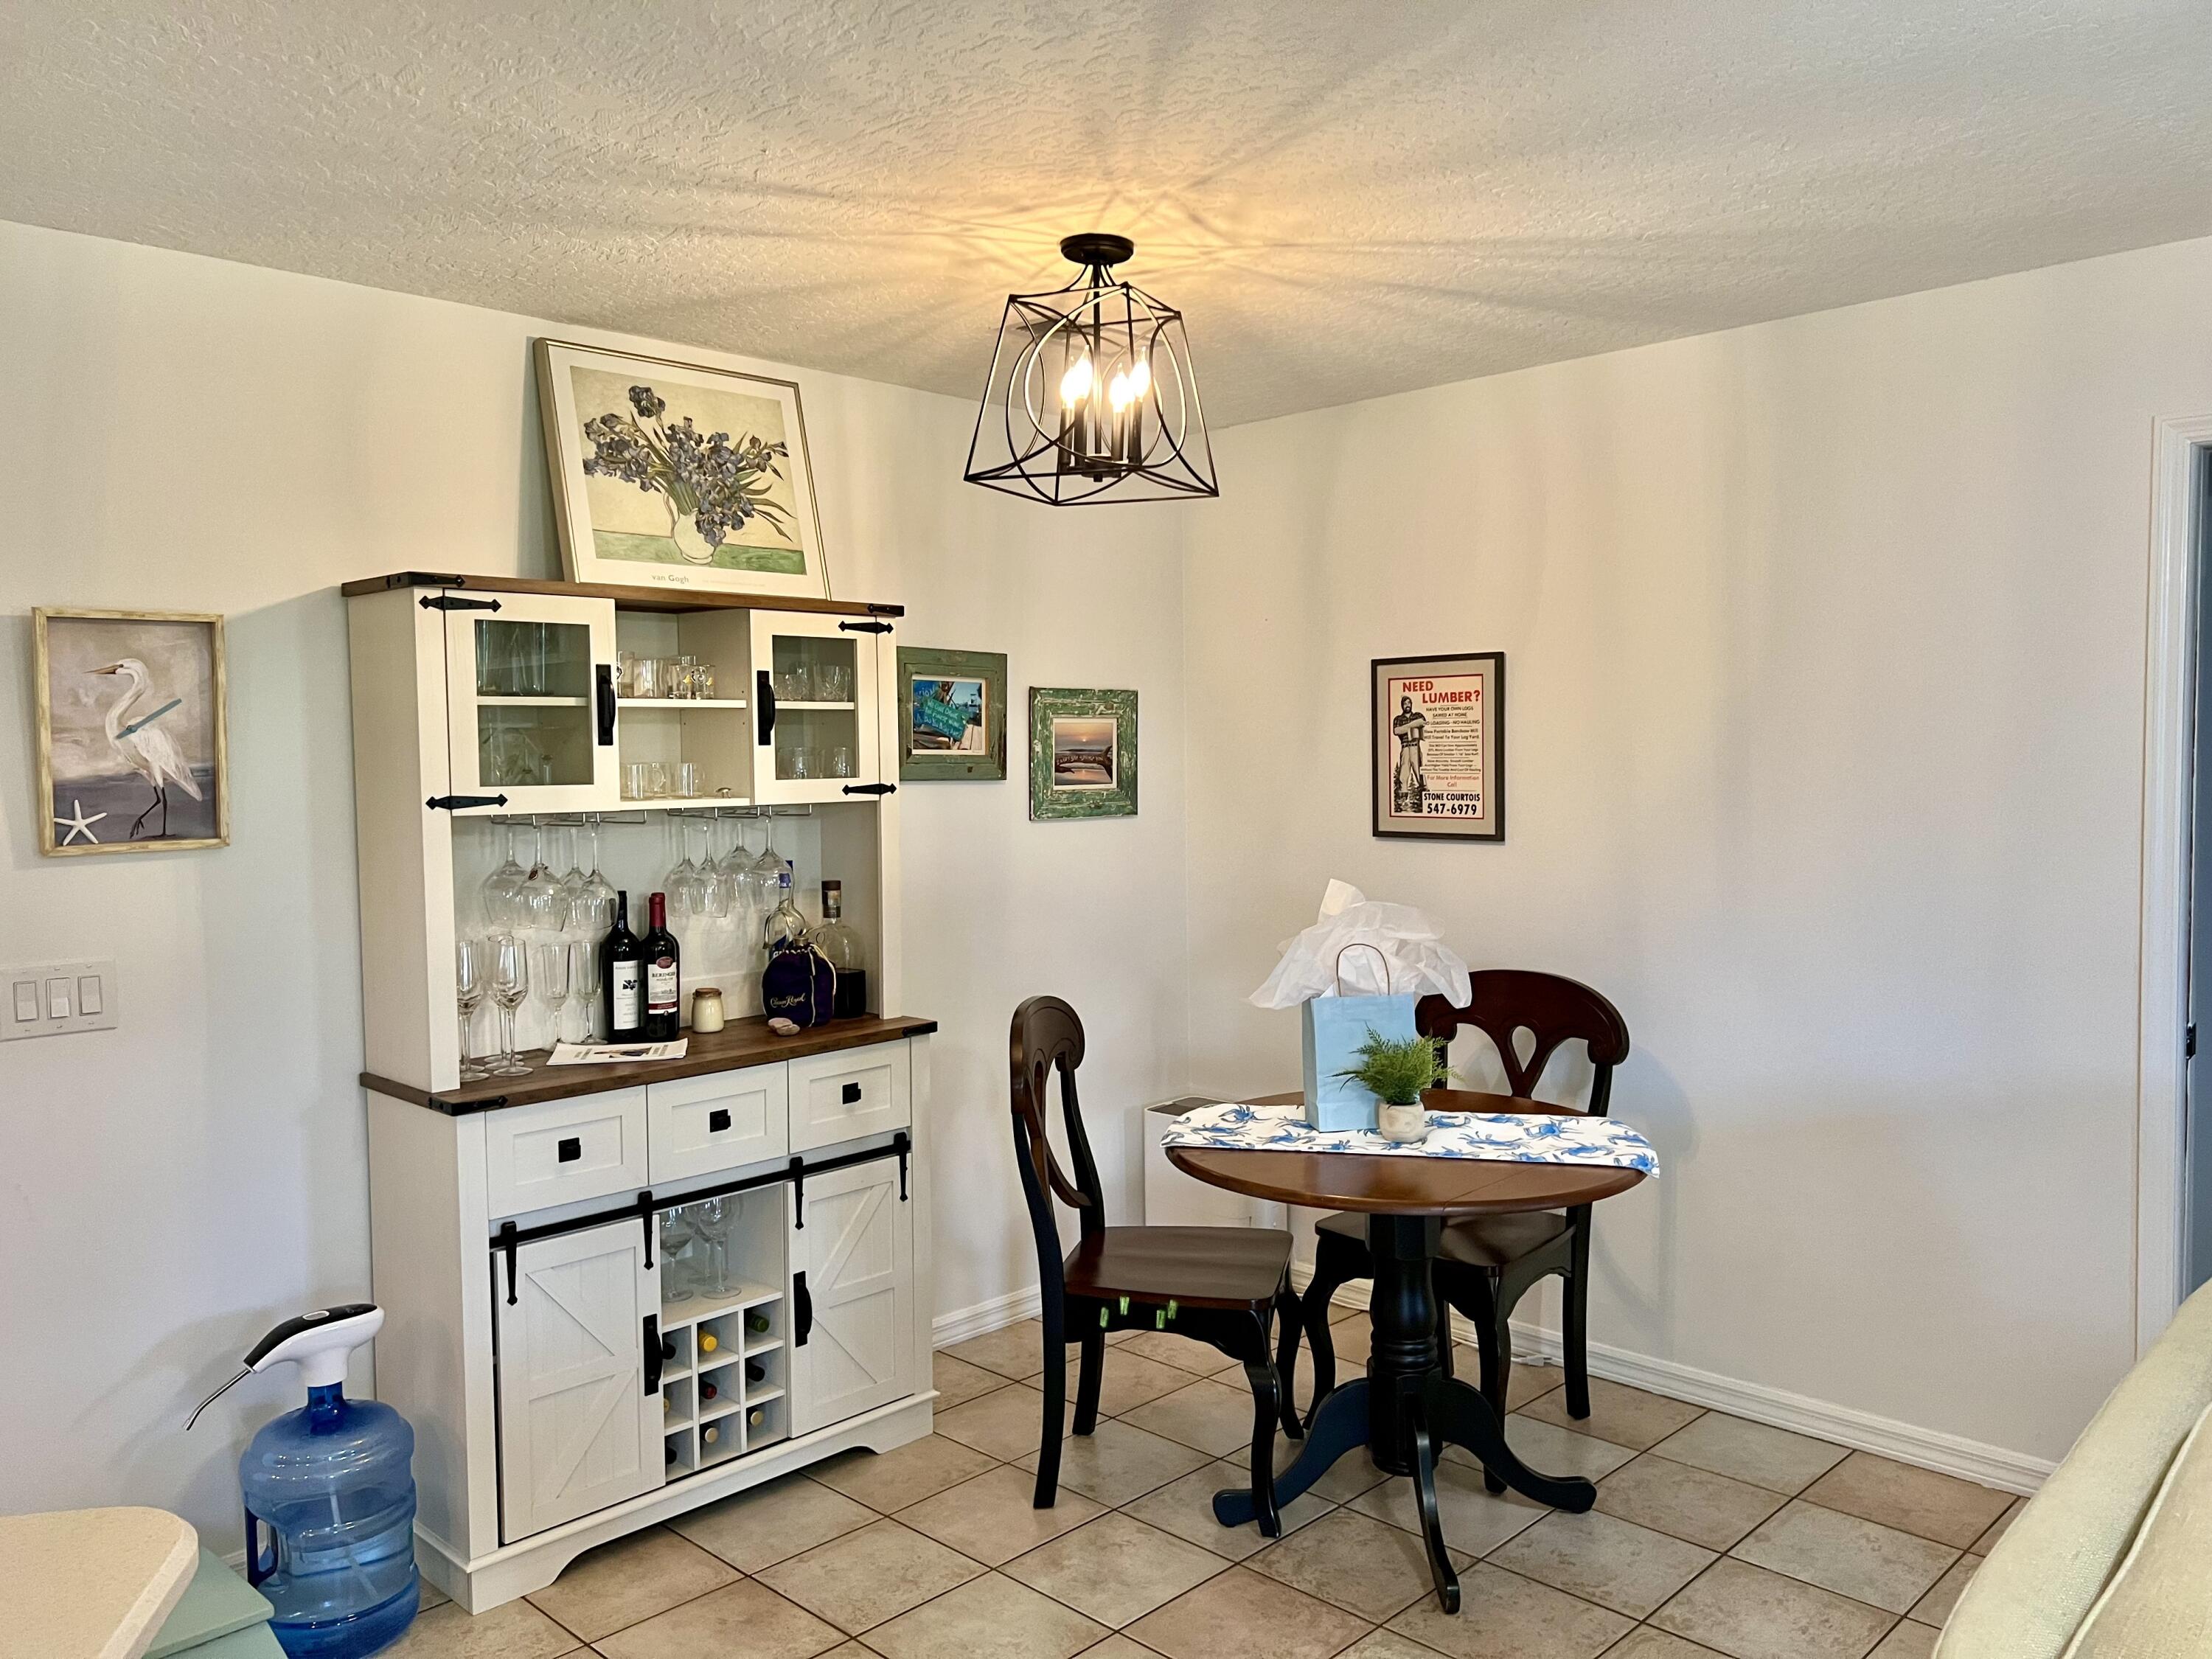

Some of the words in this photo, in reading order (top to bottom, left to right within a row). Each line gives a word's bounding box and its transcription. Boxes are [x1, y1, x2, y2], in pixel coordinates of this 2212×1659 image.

[668, 574, 689, 585] Gogh
[1402, 681, 1433, 692] NEED
[1422, 689, 1481, 703] LUMBER?
[1424, 793, 1444, 801] STONE
[1446, 793, 1480, 801] COURTOIS
[1427, 803, 1477, 815] 547-6979
